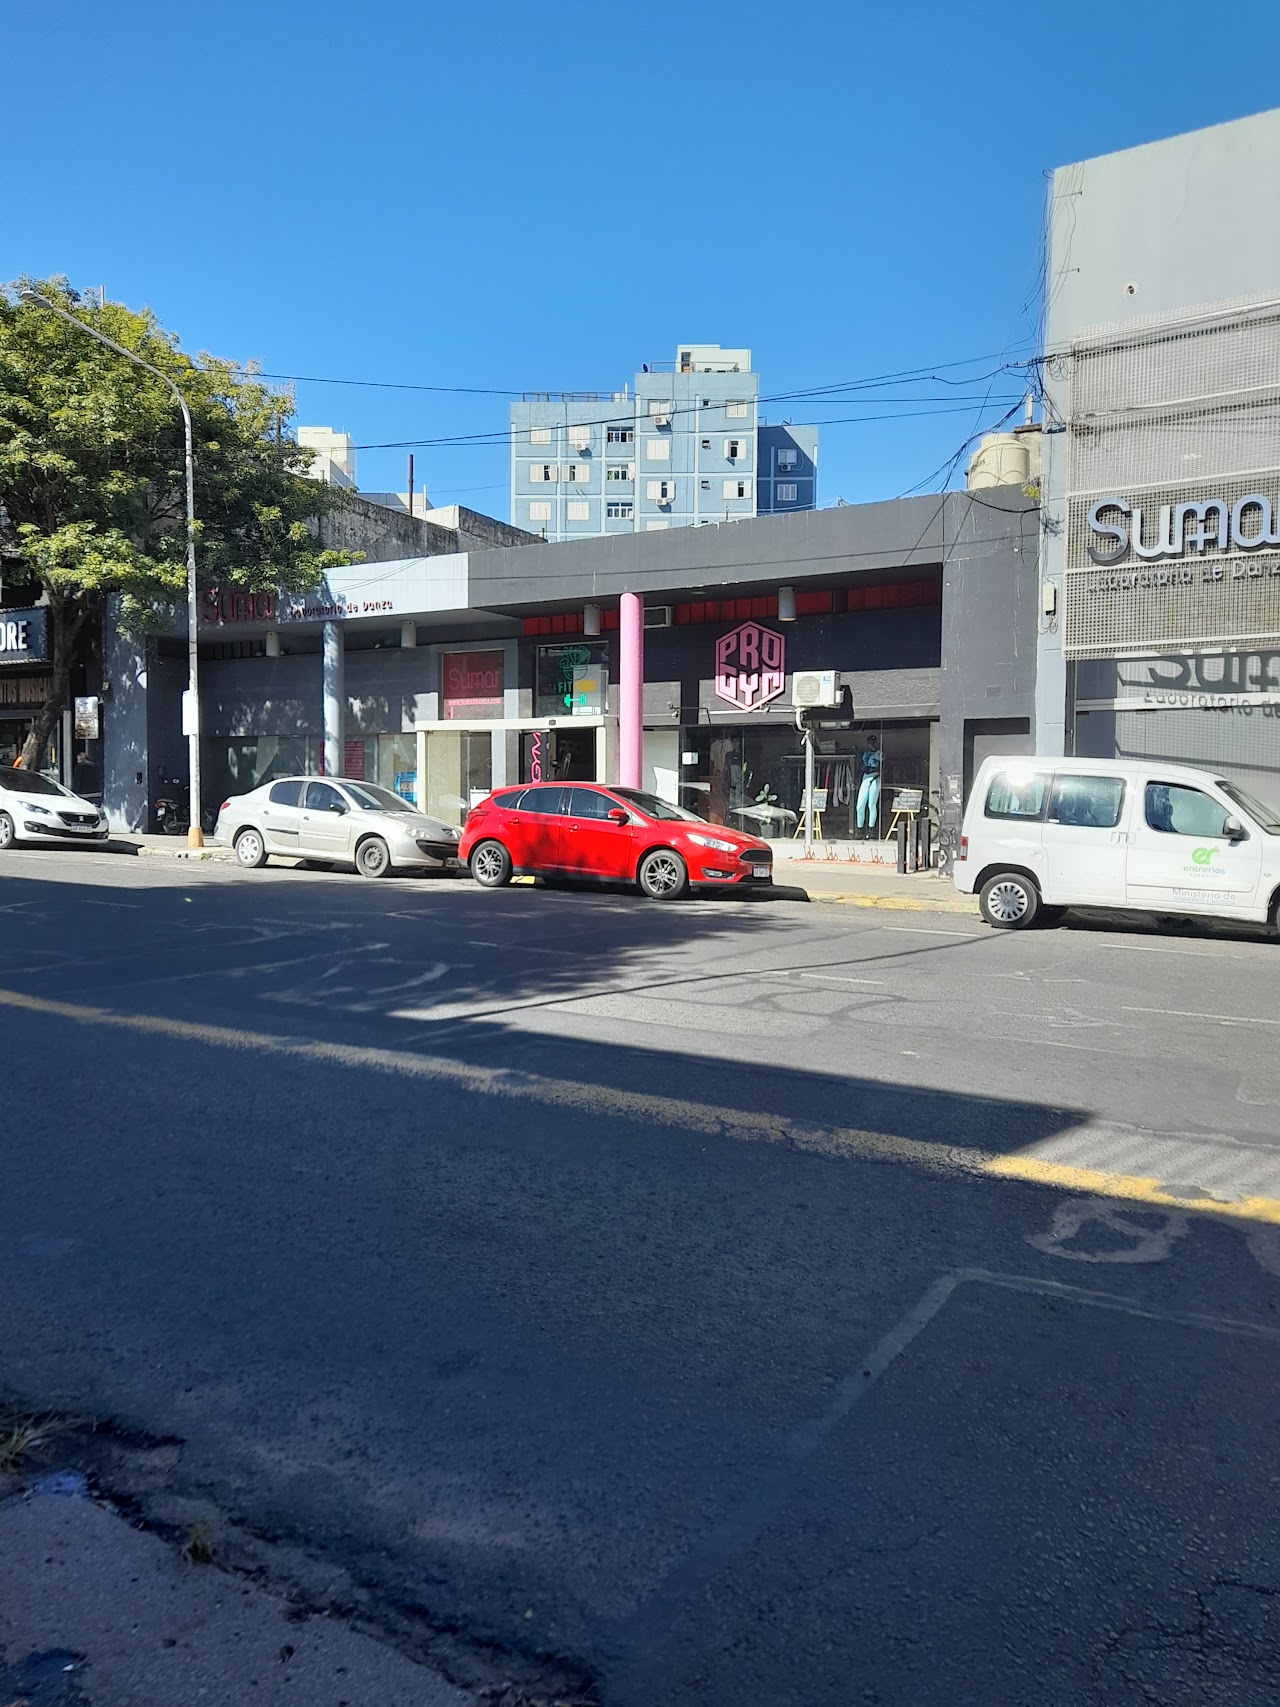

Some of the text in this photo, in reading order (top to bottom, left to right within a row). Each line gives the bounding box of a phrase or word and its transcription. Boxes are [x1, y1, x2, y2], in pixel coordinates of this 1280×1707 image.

[1087, 493, 1280, 563] Suma
[720, 626, 780, 670] PRO
[449, 669, 500, 691] Sumar
[558, 681, 573, 693] FIT
[720, 662, 780, 706] GYM
[1172, 888, 1236, 901] Ministerio de
